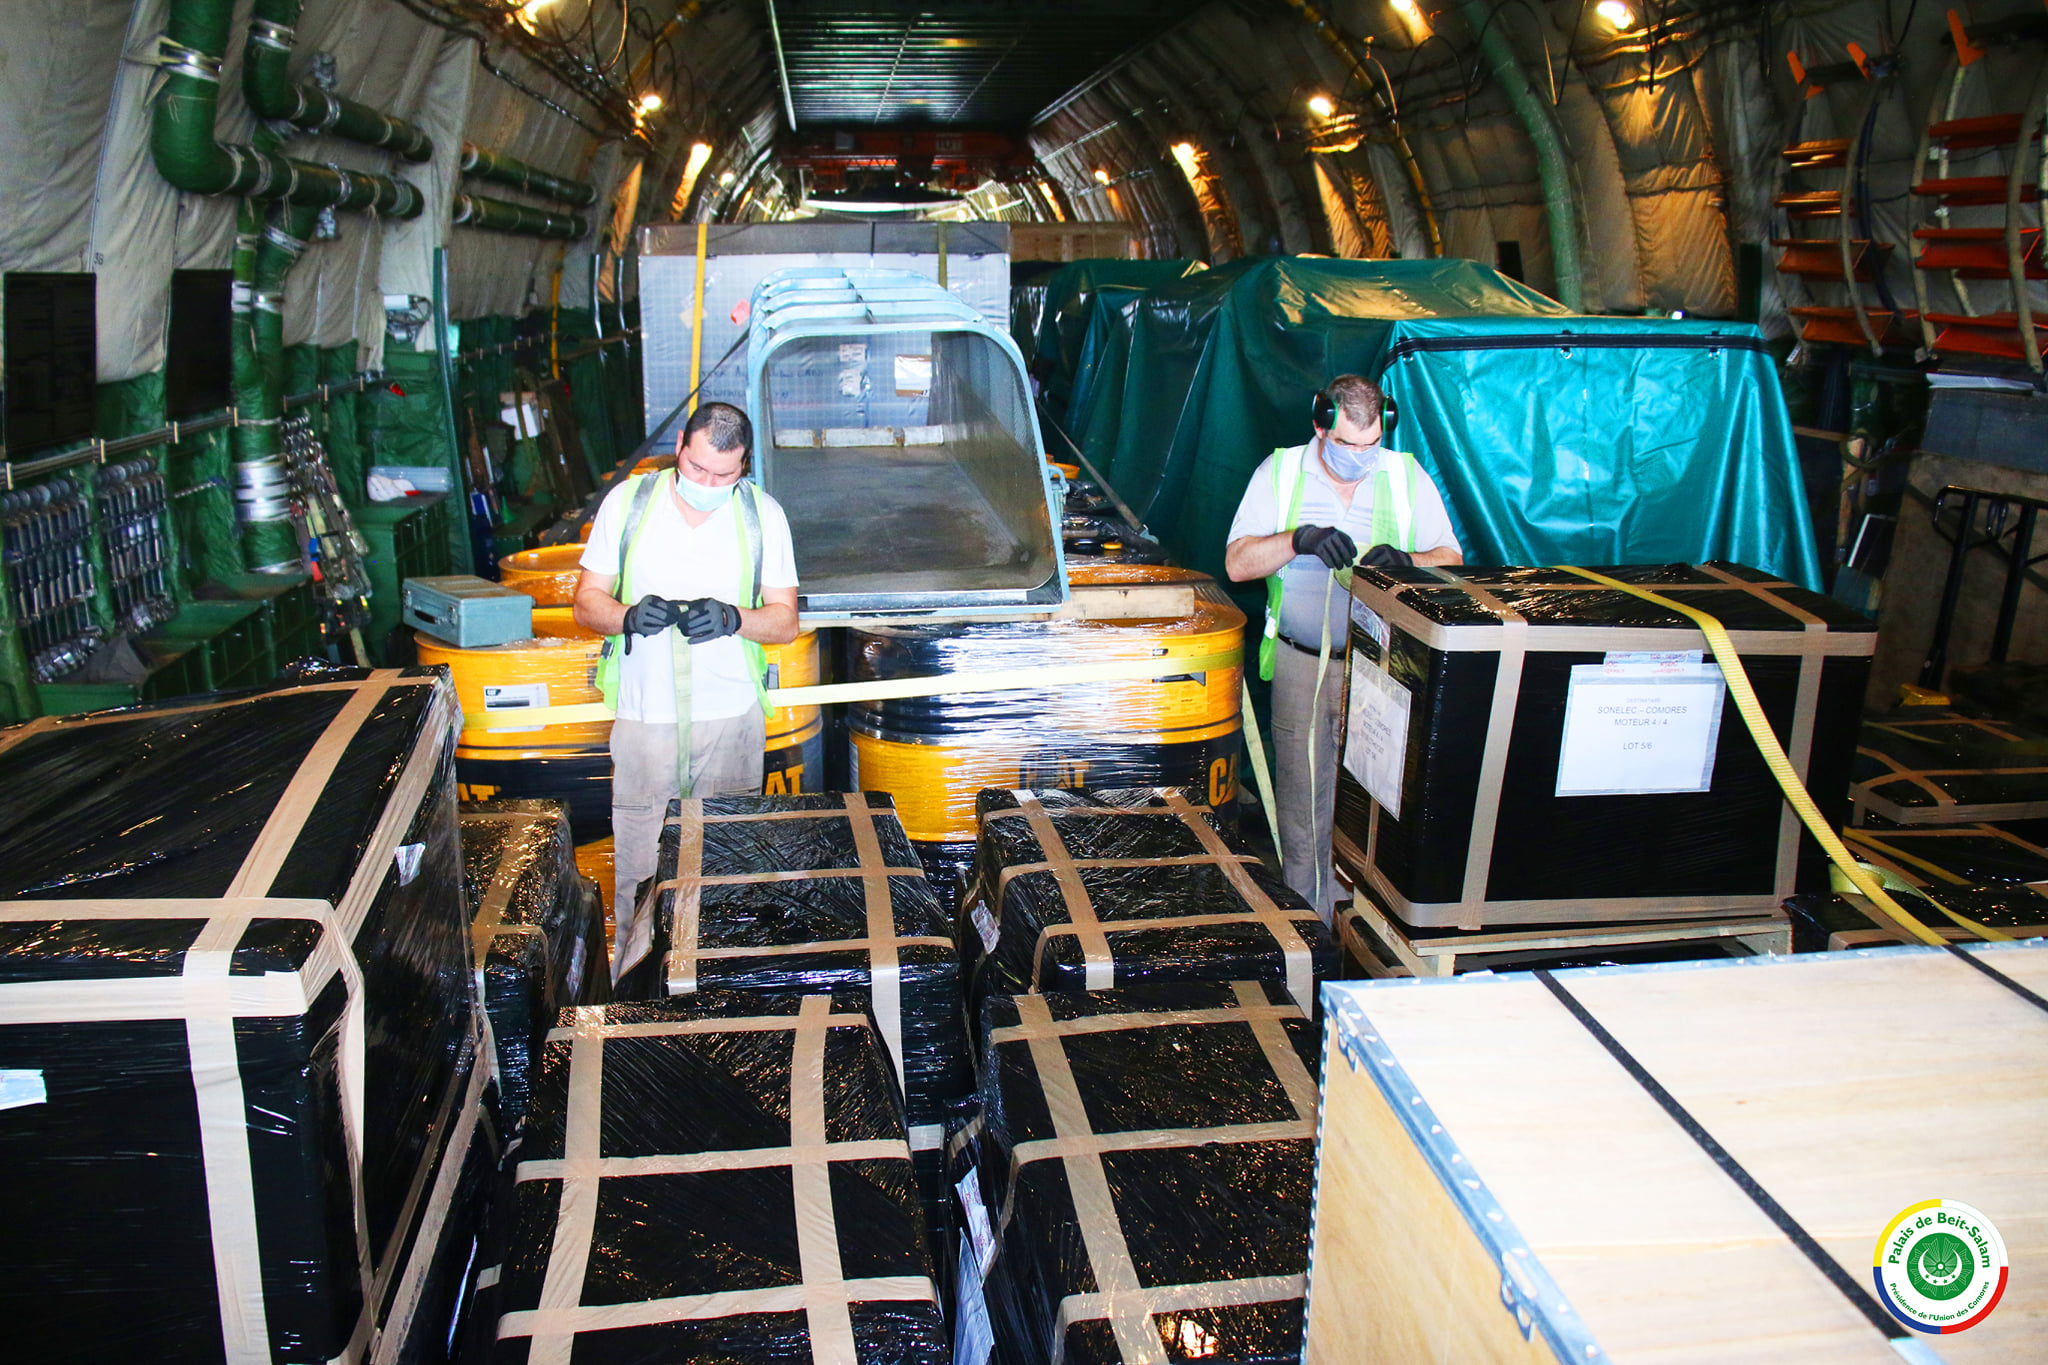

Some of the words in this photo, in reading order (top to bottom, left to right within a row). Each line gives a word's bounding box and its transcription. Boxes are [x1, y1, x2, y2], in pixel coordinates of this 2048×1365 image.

[1597, 706, 1637, 714] SONELEC
[1645, 706, 1688, 714] COMORES
[1614, 718, 1650, 726] MOTEUR
[1623, 742, 1639, 750] LOT
[765, 763, 805, 797] AT
